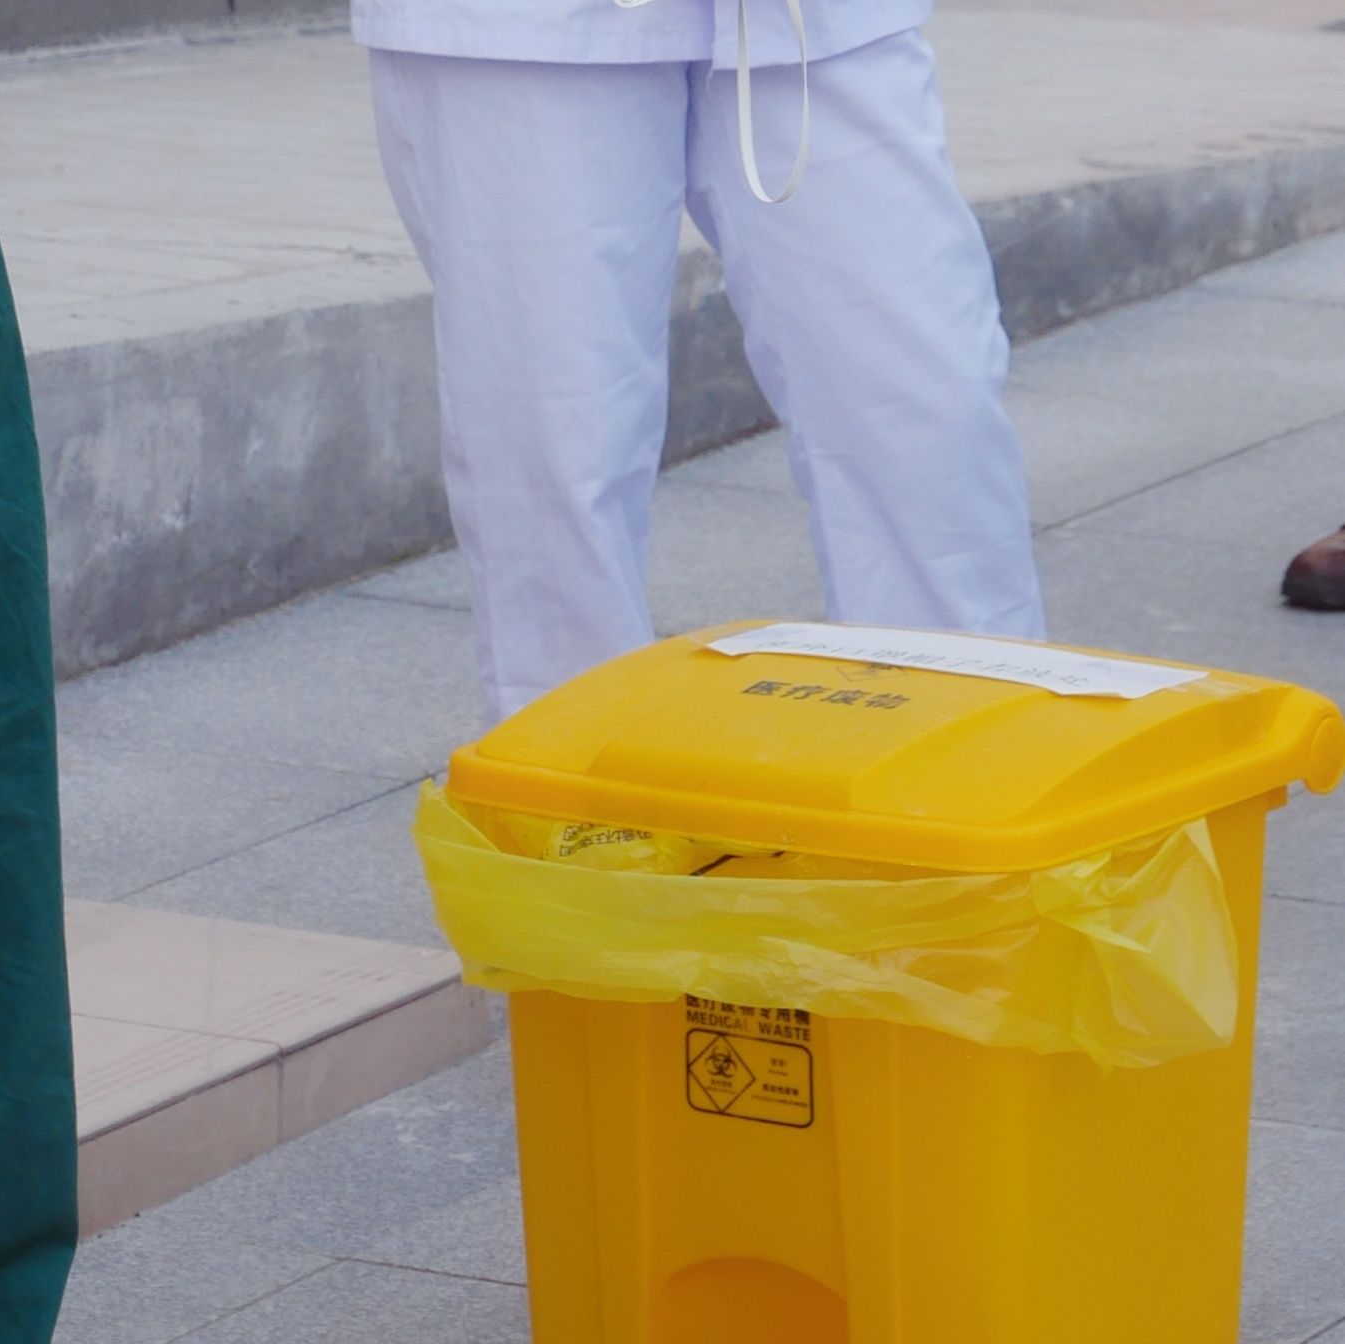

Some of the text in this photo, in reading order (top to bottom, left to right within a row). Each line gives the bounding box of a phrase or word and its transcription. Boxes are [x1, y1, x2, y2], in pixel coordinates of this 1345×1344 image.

[742, 680, 911, 710] 医疗废物
[686, 1009, 811, 1042] MEDICAL WASTE
